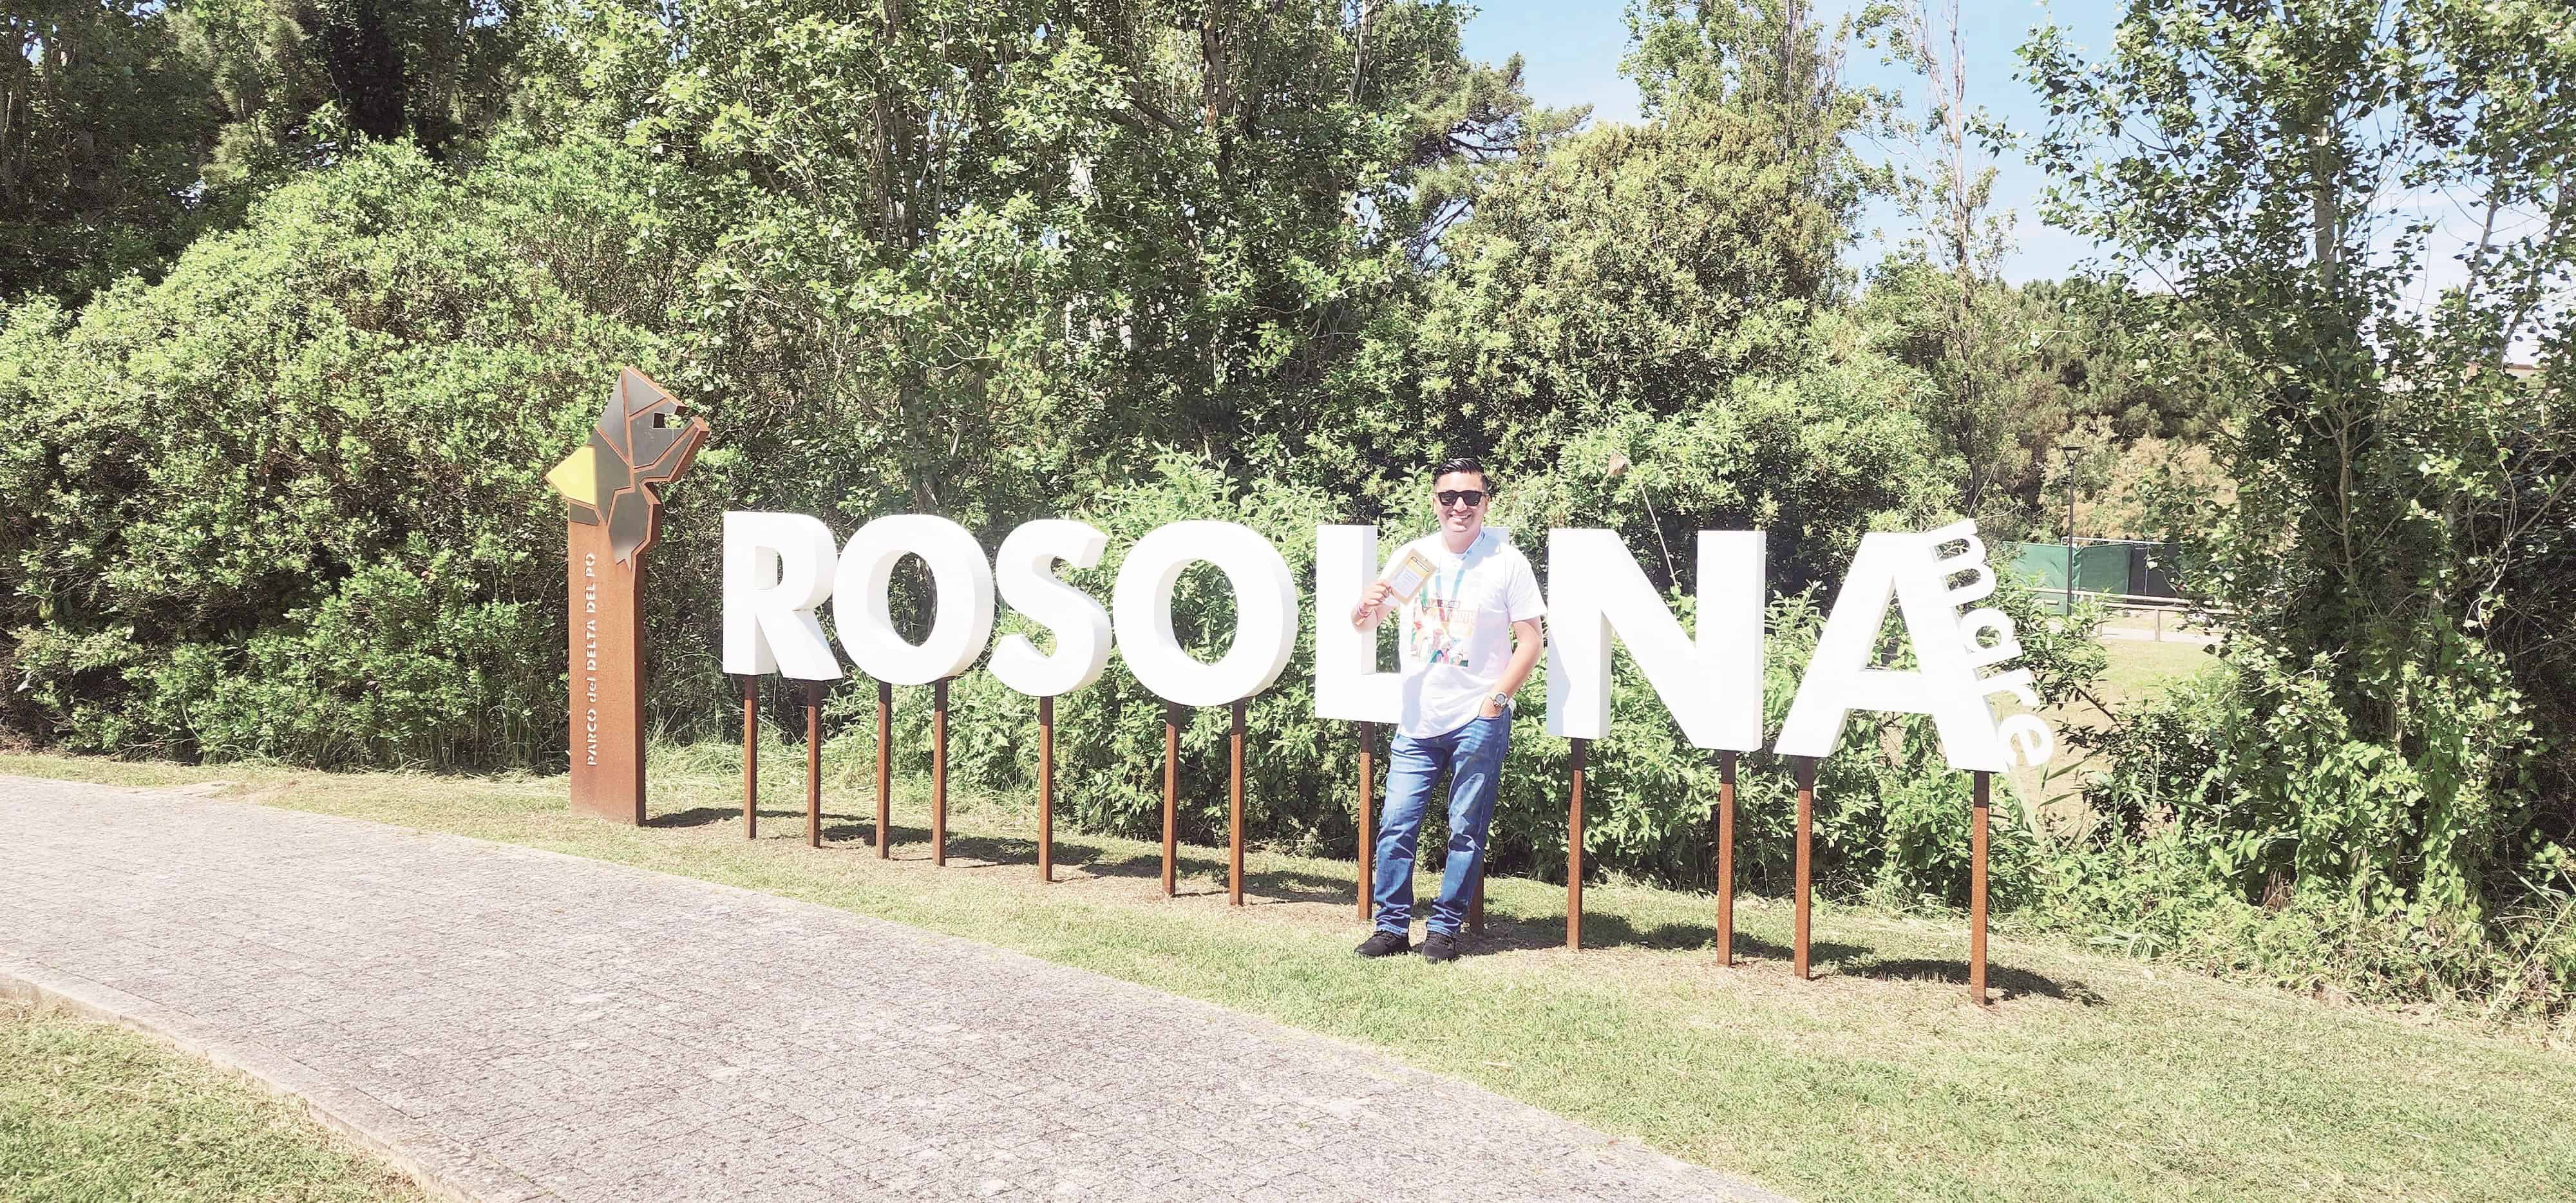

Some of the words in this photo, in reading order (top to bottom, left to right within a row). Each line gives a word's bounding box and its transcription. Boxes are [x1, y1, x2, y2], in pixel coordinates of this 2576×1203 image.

[584, 552, 596, 577] PO
[585, 582, 596, 613] DEL
[586, 618, 597, 670] DELTA
[723, 511, 2009, 772] ROSOLNA
[1928, 518, 2054, 770] mare
[586, 676, 597, 703] del
[587, 708, 598, 766] PARCO
